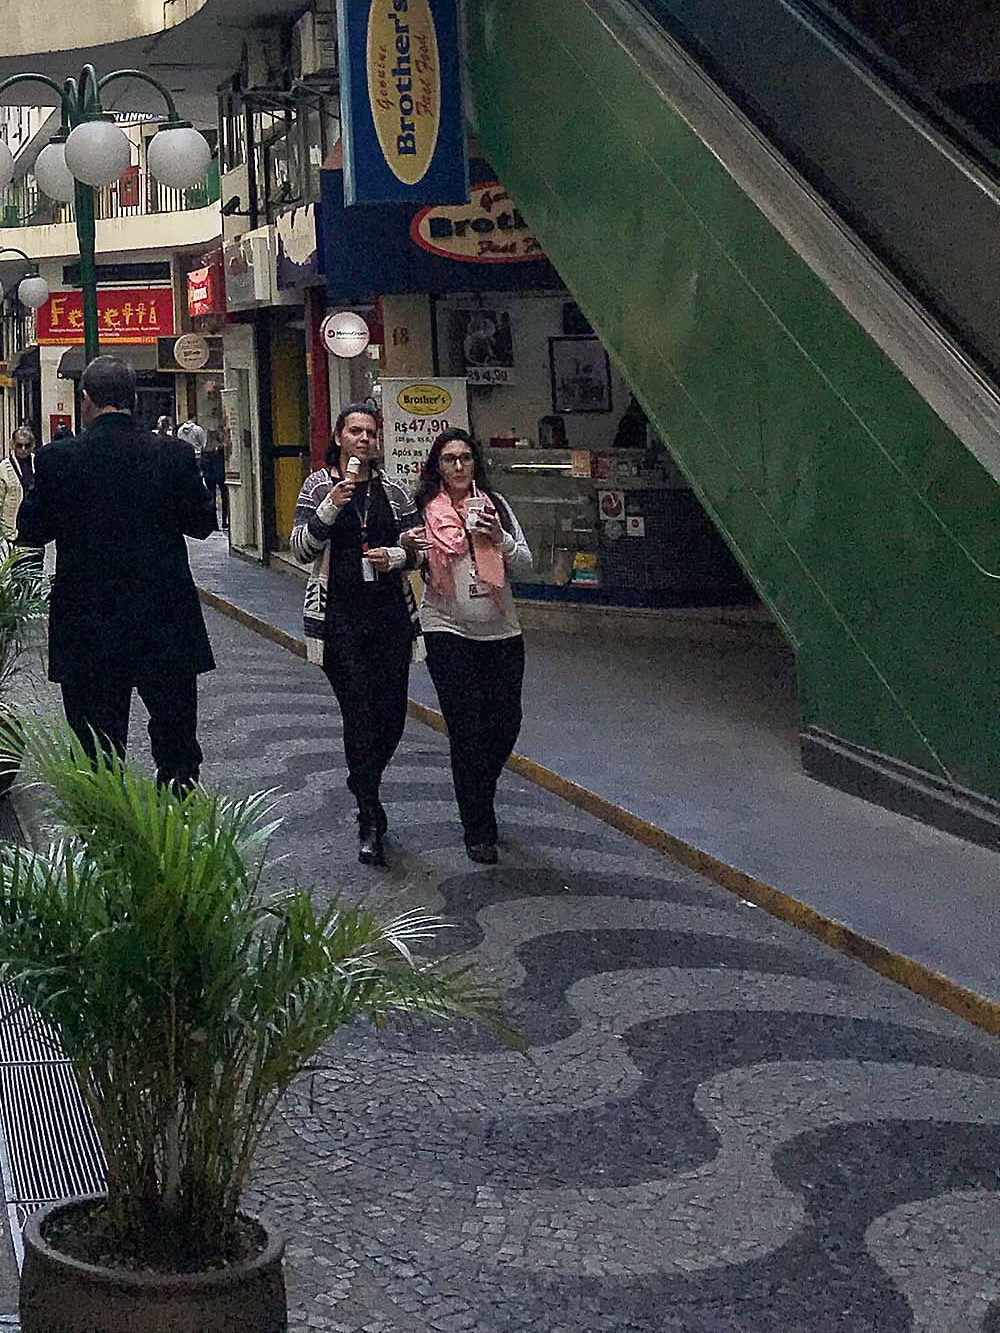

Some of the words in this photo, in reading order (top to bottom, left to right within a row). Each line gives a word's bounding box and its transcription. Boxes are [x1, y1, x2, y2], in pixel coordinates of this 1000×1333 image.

[413, 32, 435, 72] Food
[403, 394, 446, 405] Brother's
[391, 448, 412, 458] Após
